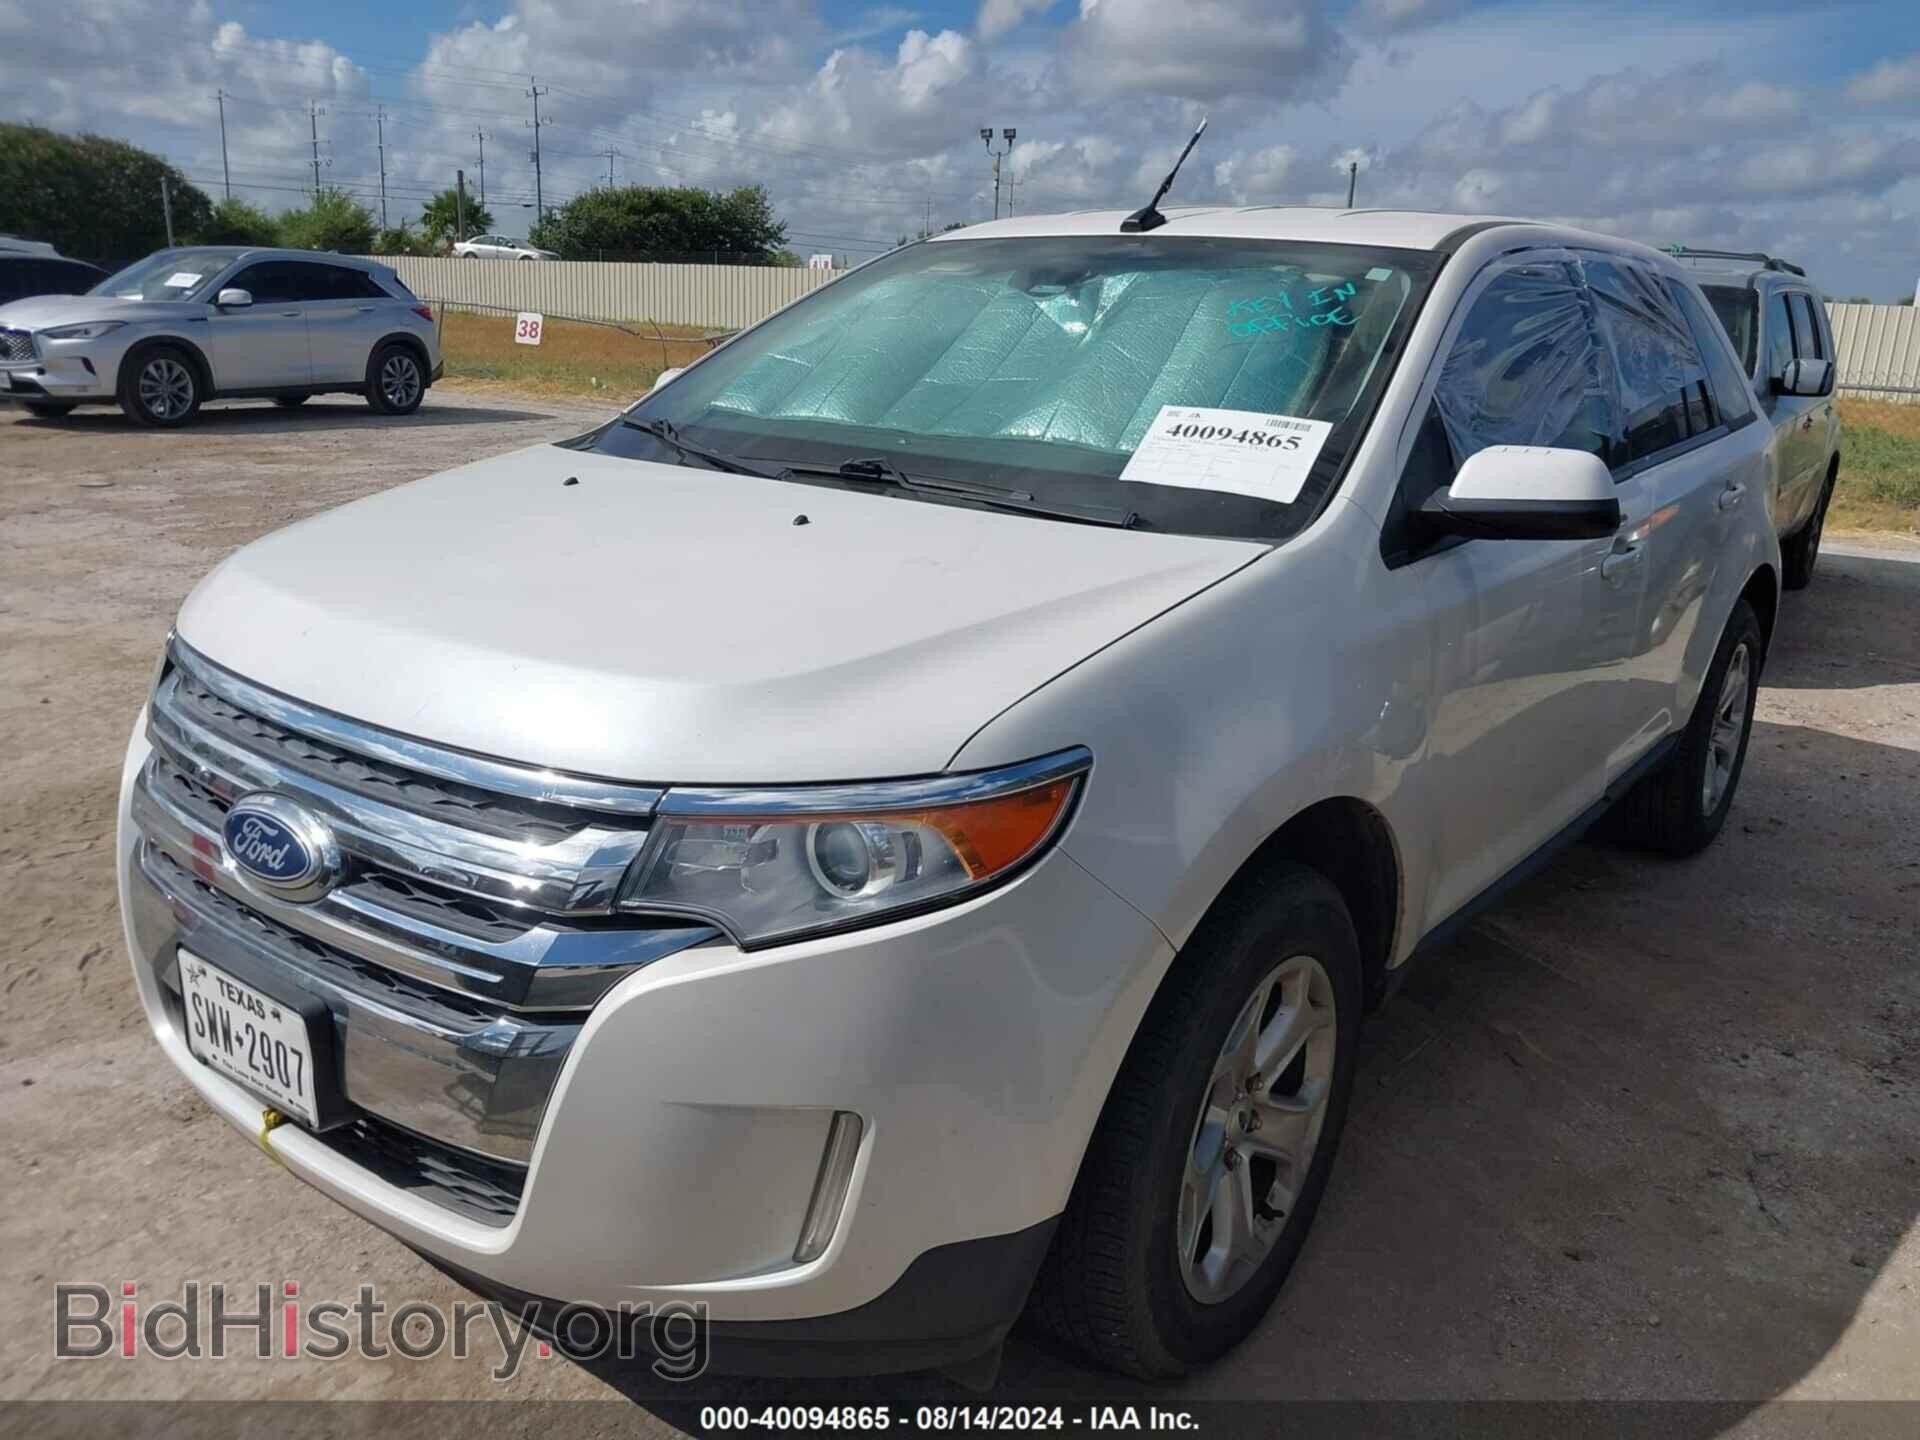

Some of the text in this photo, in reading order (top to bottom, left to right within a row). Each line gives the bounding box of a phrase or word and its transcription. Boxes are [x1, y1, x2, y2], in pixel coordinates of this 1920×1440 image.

[1307, 282, 1357, 306] IN
[518, 320, 540, 339] 38
[1165, 422, 1303, 451] 40094865
[234, 817, 291, 871] Ford
[215, 975, 266, 1020] TEXAS
